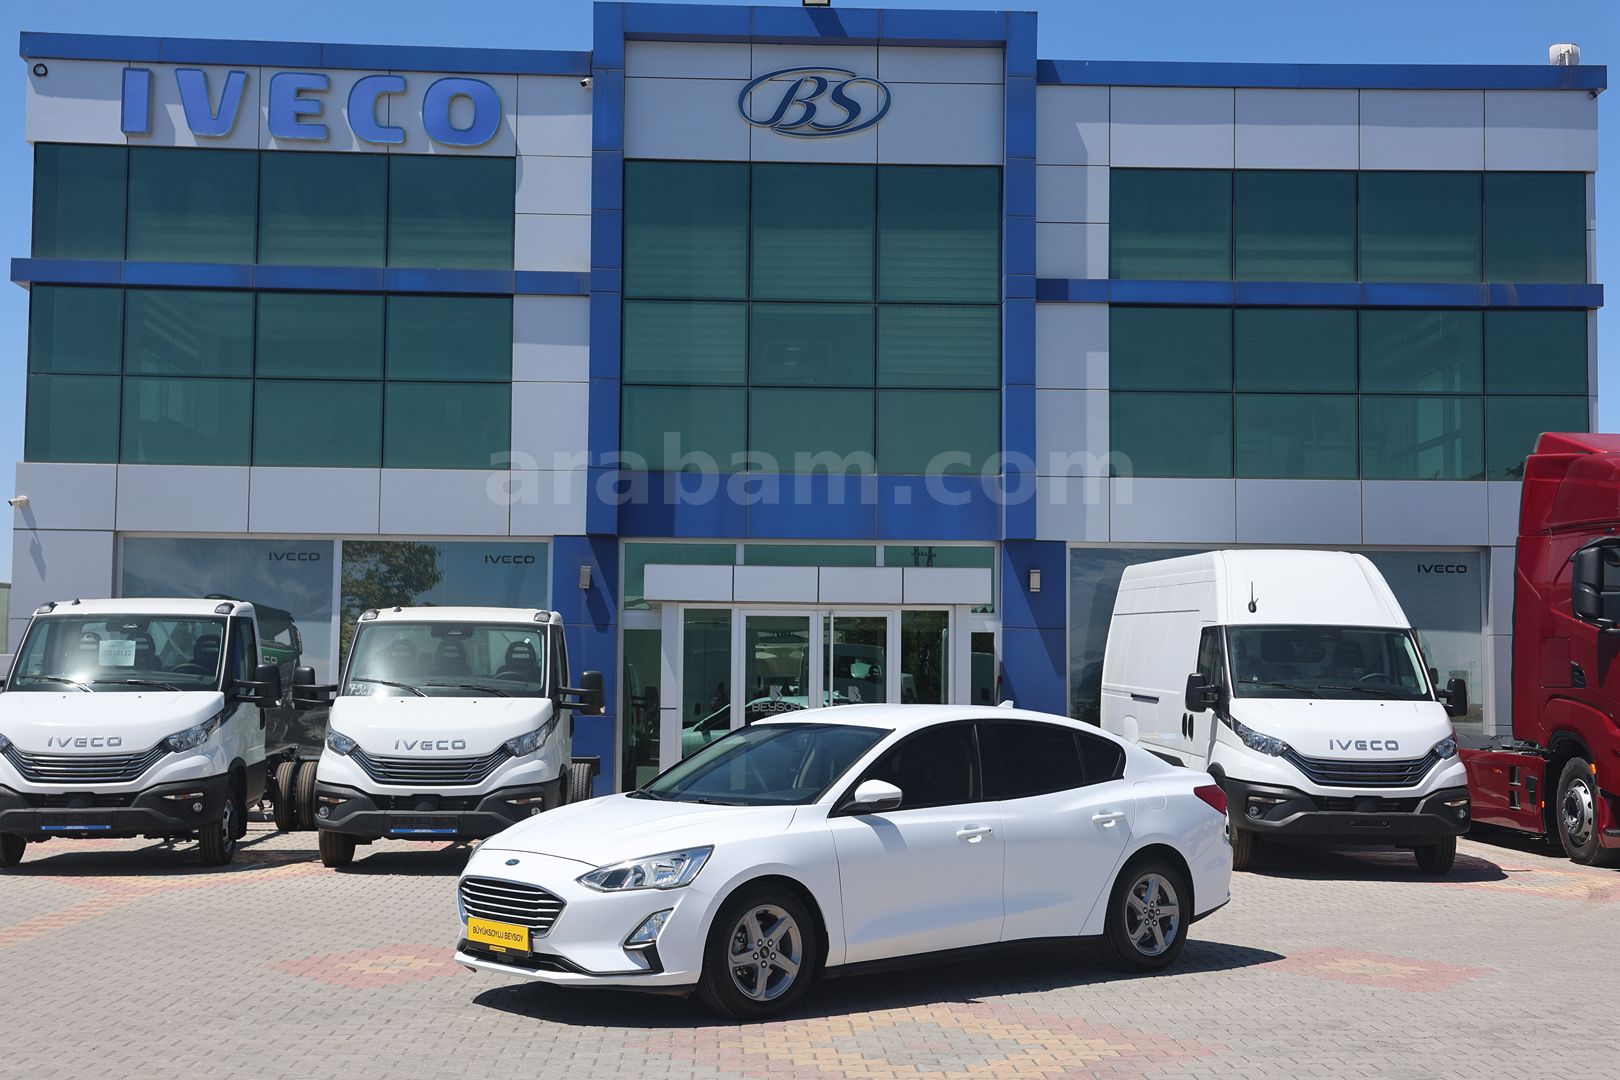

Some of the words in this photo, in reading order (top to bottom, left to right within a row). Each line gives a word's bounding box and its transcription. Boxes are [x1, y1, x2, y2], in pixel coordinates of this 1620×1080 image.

[120, 67, 502, 147] IVECO
[269, 551, 320, 562] IVECO
[484, 554, 536, 564] IVECO
[1417, 564, 1468, 574] IVECO
[751, 702, 801, 712] BEYSOY
[47, 735, 122, 748] IVECO
[394, 738, 466, 751] IVECO
[1328, 738, 1400, 752] IVECO
[472, 925, 504, 939] BÜYÜKSOYLU
[504, 931, 524, 943] BEYSOY
